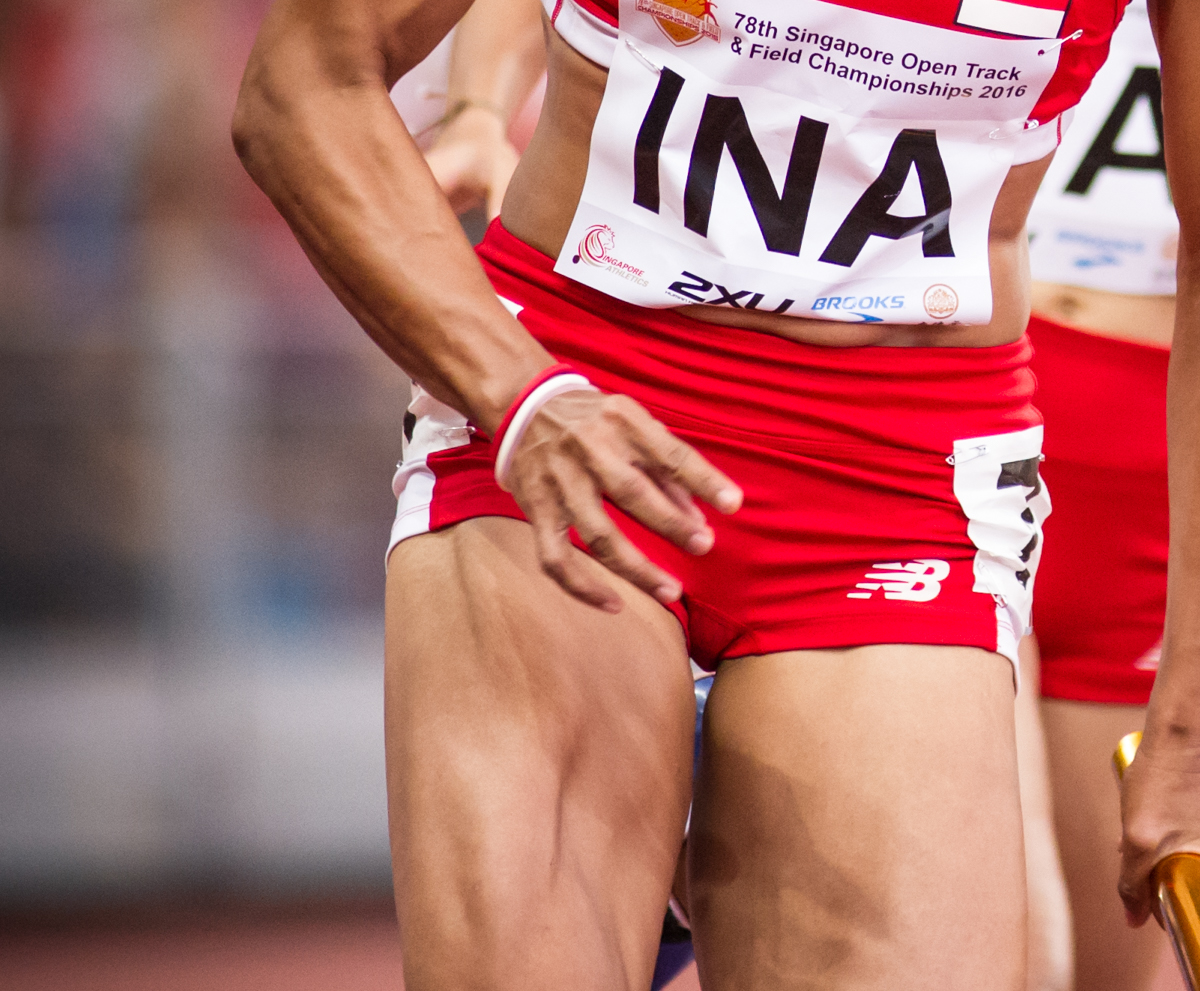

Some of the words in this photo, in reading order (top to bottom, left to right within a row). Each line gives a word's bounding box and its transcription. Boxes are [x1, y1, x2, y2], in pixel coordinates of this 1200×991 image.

[730, 36, 742, 55] &
[749, 43, 802, 64] Field
[808, 52, 973, 100] Championships
[978, 85, 1028, 99] 2016
[734, 12, 778, 39] 78th
[785, 26, 894, 65] Singapore
[901, 52, 958, 76] Open
[966, 62, 1021, 81] Track
[633, 66, 956, 268] INA
[605, 265, 649, 287] ATHLETICS
[667, 271, 796, 314] 2XU
[811, 295, 905, 311] BROOKS
